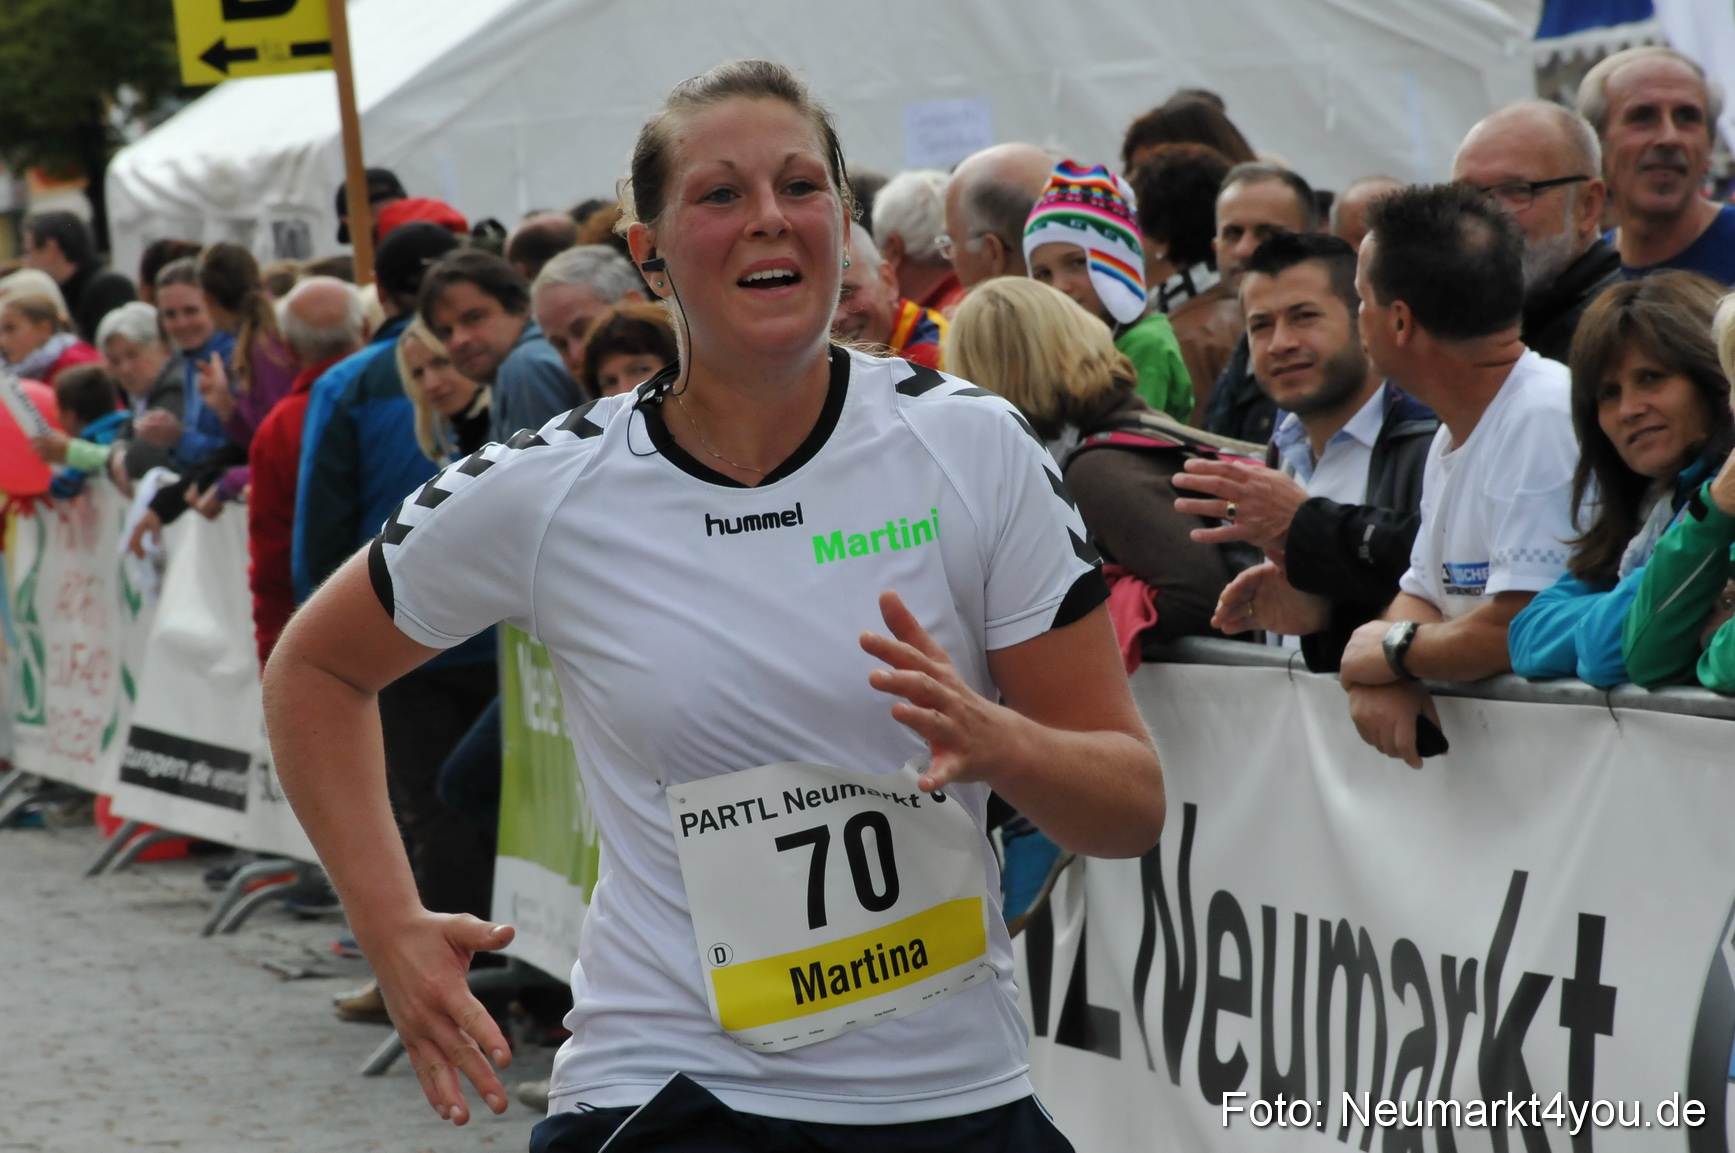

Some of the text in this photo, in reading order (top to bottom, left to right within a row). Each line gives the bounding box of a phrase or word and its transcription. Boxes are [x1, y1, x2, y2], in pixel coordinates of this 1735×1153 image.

[704, 502, 804, 537] hummel
[812, 508, 940, 564] Martini
[680, 784, 922, 838] PARTL Neumarkt
[774, 810, 900, 931] 70
[789, 938, 929, 1006] Martina
[1132, 802, 1618, 1153] Neumarkt
